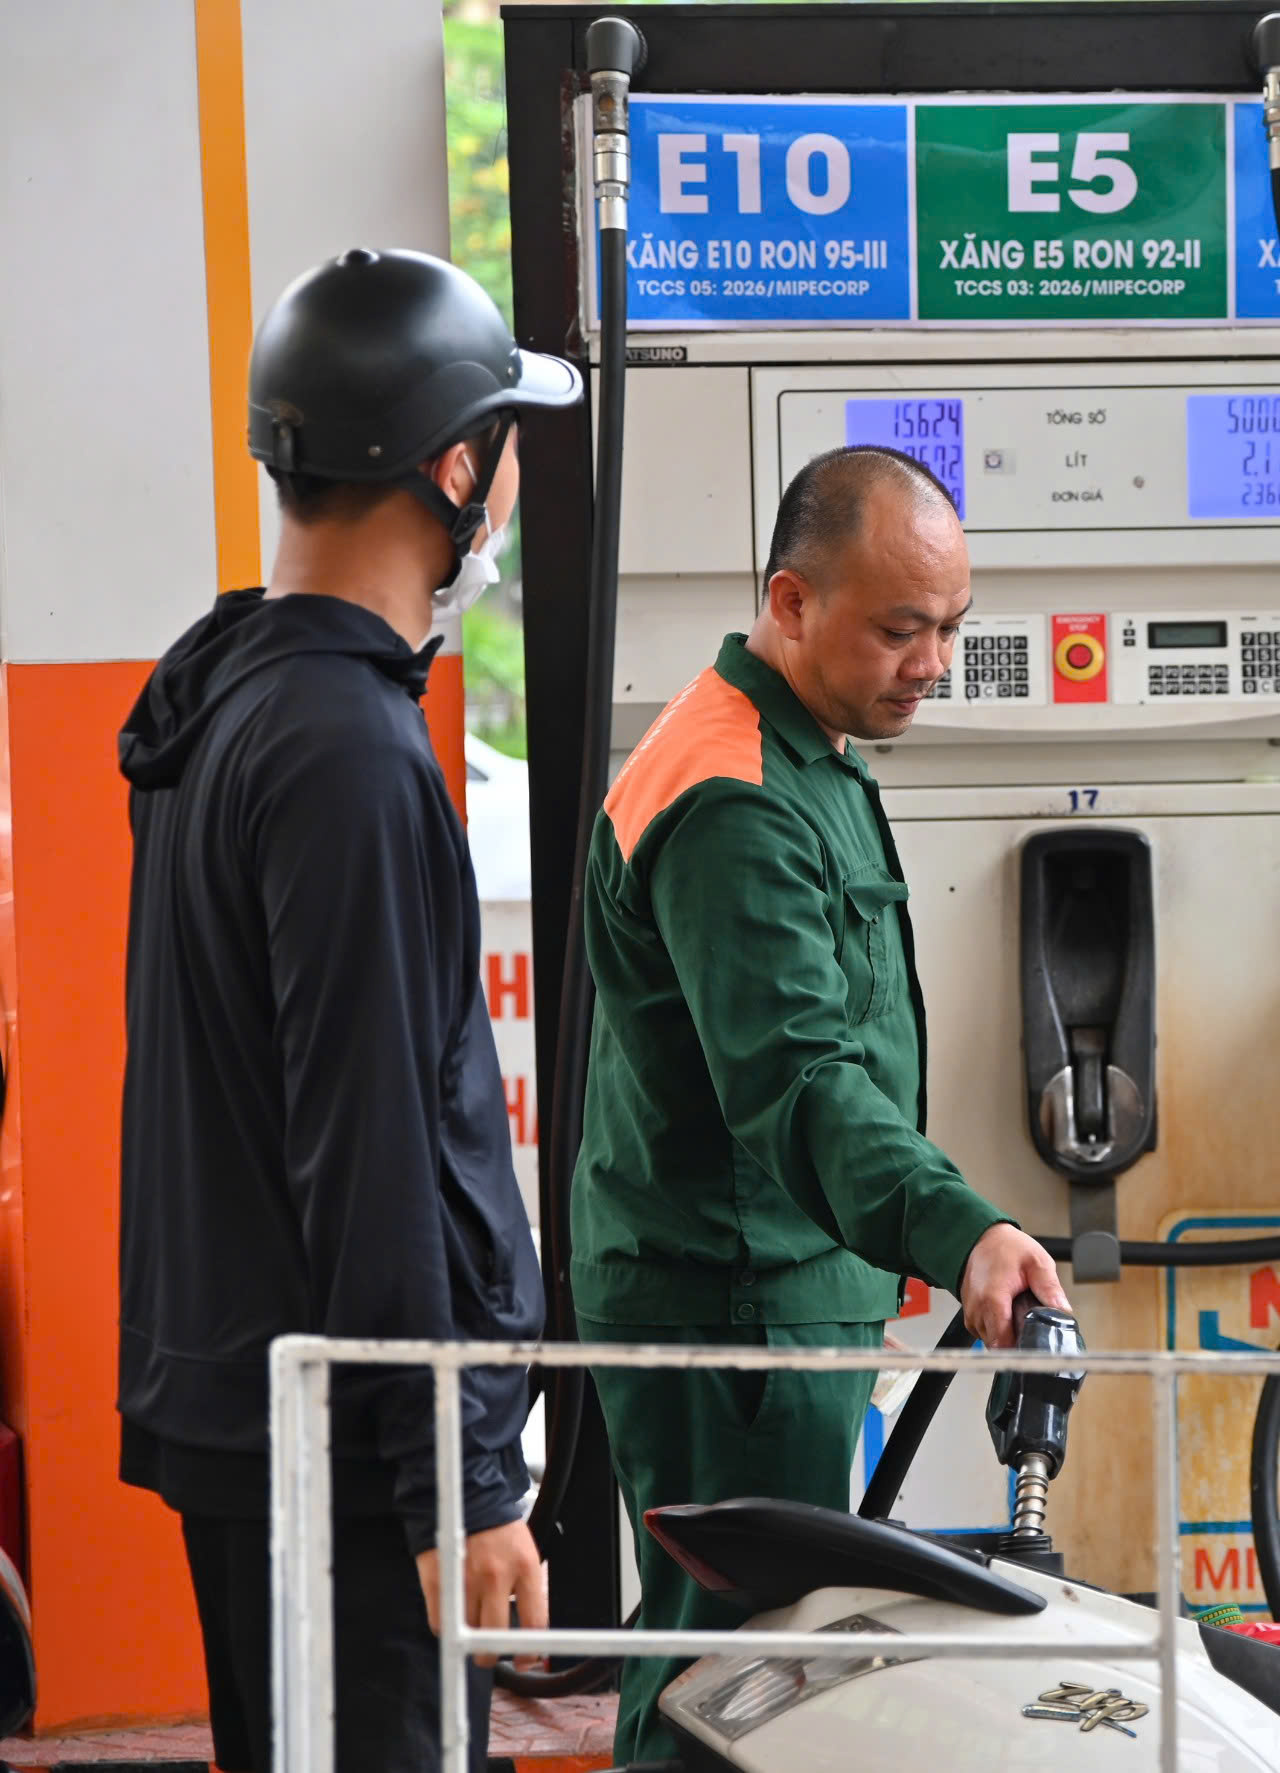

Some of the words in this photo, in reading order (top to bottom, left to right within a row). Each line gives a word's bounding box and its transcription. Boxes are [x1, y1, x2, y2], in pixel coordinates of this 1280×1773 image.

[657, 132, 851, 215] E10
[1007, 132, 1138, 213] E5
[707, 240, 752, 269] E10
[760, 240, 817, 269] RON
[824, 240, 888, 269] 95-III
[939, 232, 1025, 269] XĂNG
[1033, 239, 1065, 269] E5
[1073, 239, 1134, 269] RON
[1142, 239, 1201, 269] 92-II
[637, 280, 685, 296] TCCS
[690, 280, 717, 296] 05:
[723, 279, 870, 298] 2026/MIPECORP
[954, 279, 1003, 296] TCCS
[1007, 279, 1034, 296] 03:
[1039, 278, 1185, 297] 2026/MIPECORP
[626, 347, 684, 361] ATSUNO
[894, 402, 960, 438] 15624
[1065, 449, 1087, 468] LÍT
[1068, 790, 1098, 811] 17
